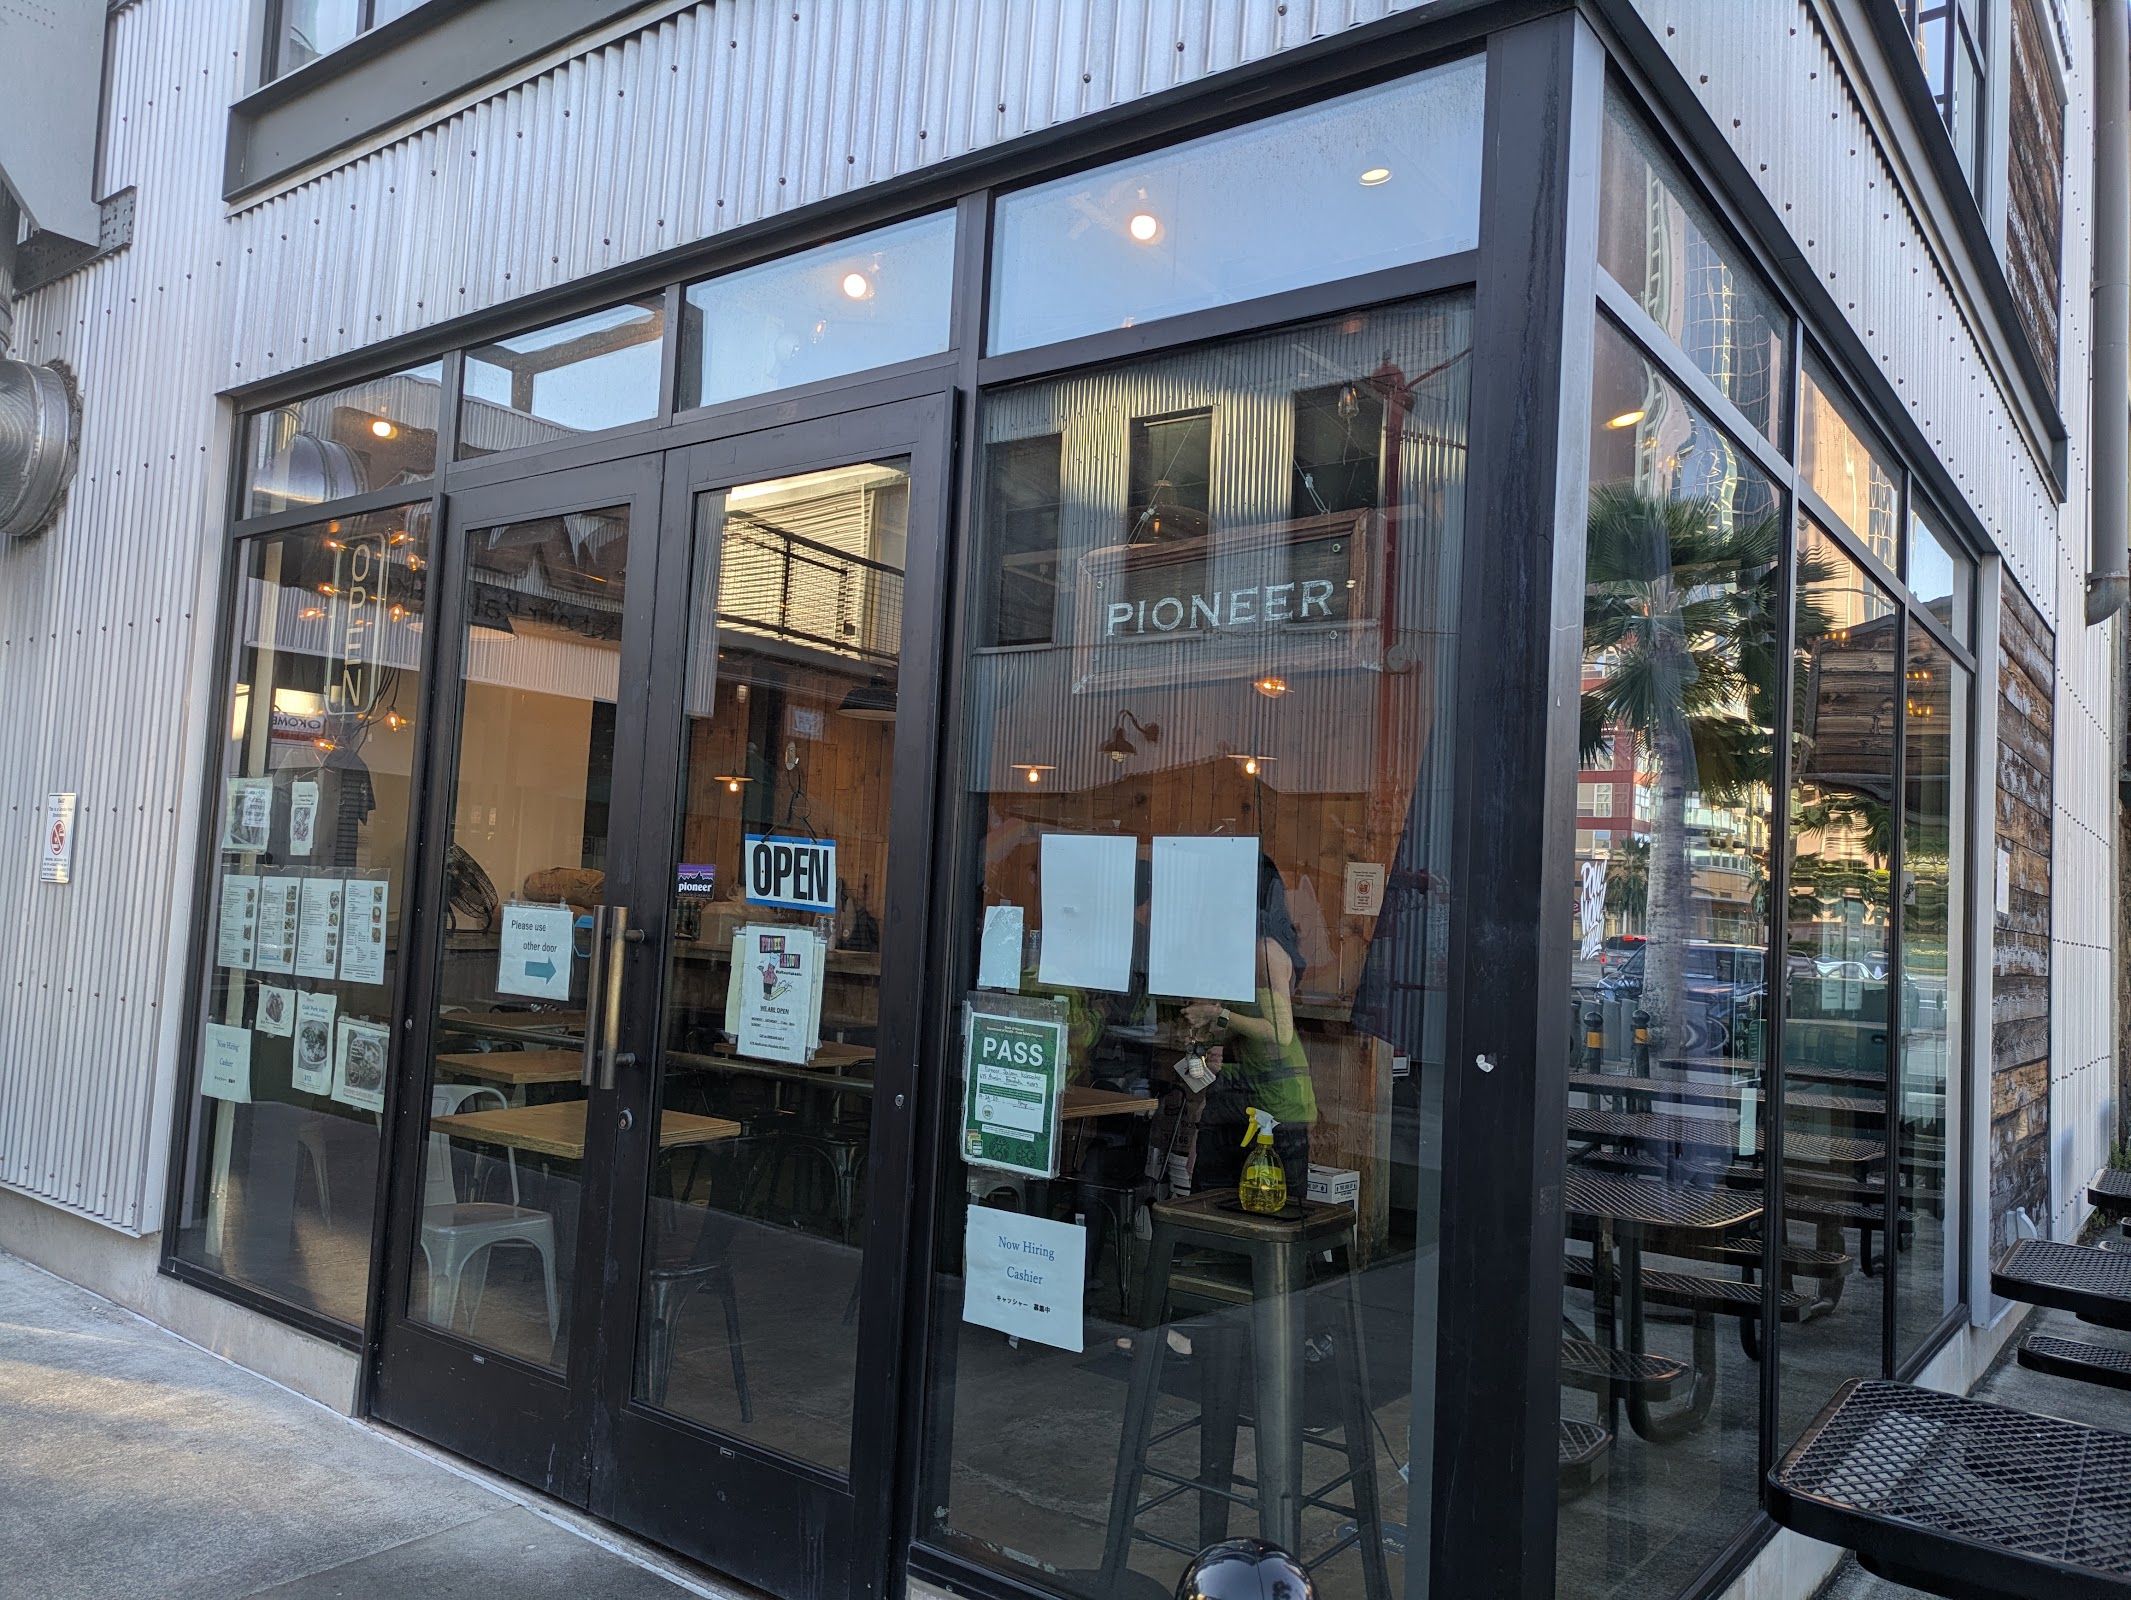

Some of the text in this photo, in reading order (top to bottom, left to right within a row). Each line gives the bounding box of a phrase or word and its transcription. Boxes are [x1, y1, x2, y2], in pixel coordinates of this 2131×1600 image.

[1106, 579, 1334, 637] PIONEER
[344, 544, 371, 706] OPEN
[753, 843, 829, 903] OPEN
[678, 881, 712, 893] pioneer
[511, 919, 547, 932] Please use
[522, 941, 558, 953] other door
[776, 1007, 790, 1015] OPEN
[982, 1037, 1044, 1067] PASS
[998, 1235, 1056, 1262] Now Hiring
[1006, 1266, 1044, 1285] Cashier
